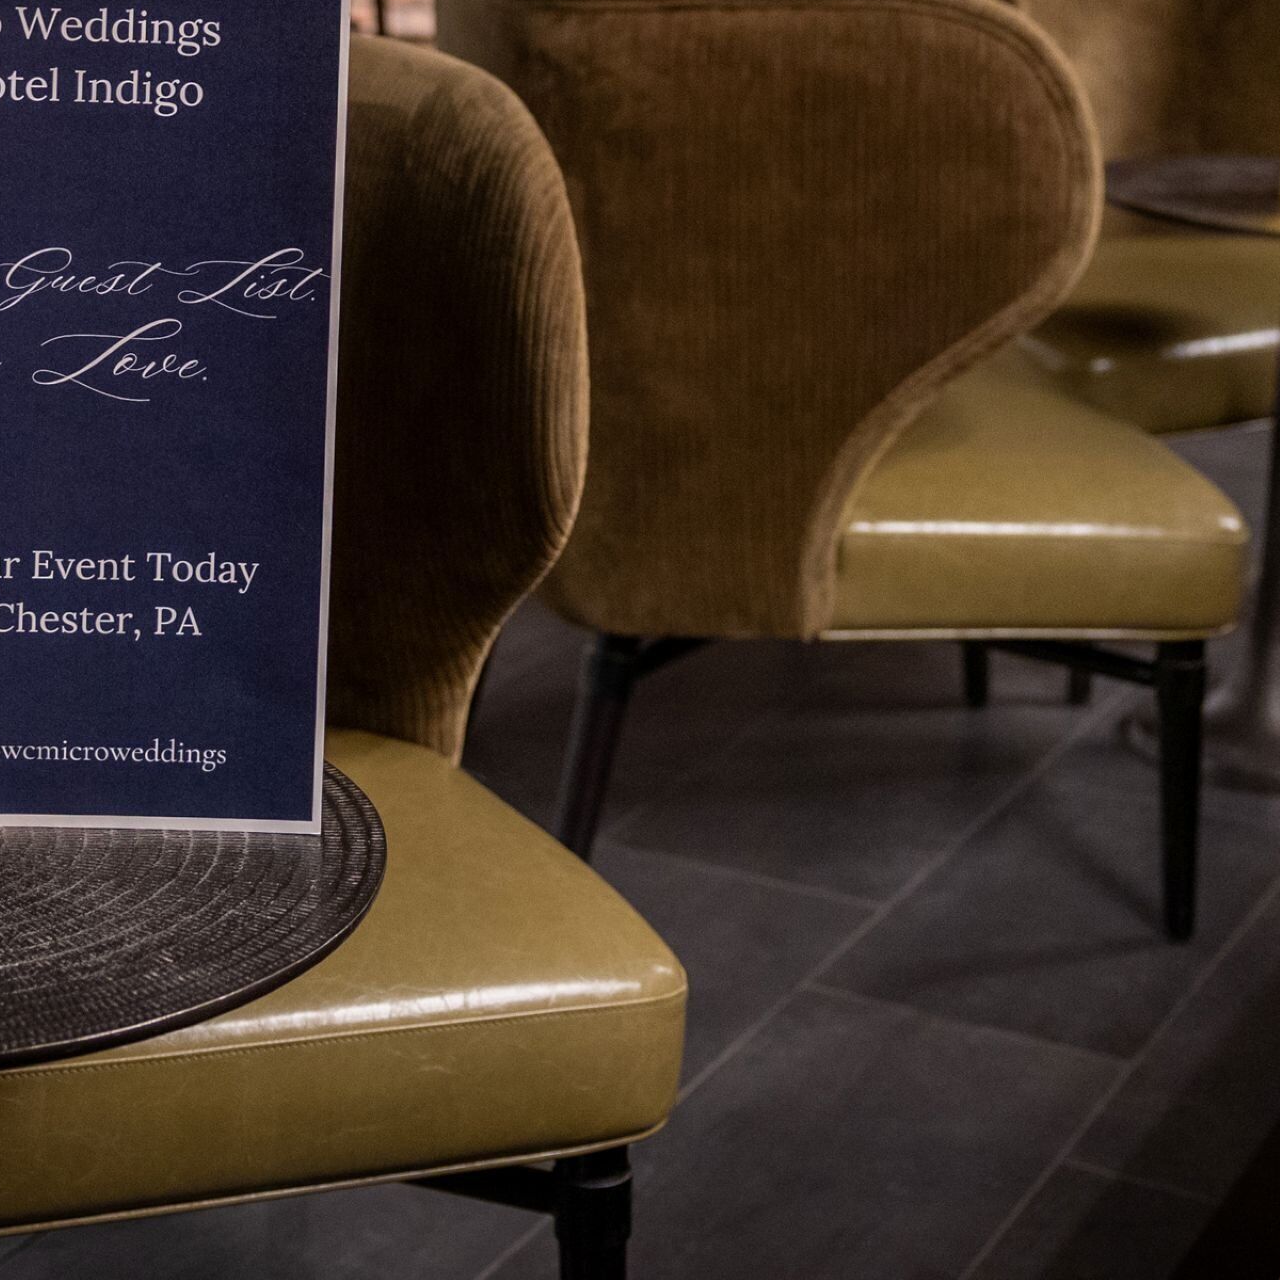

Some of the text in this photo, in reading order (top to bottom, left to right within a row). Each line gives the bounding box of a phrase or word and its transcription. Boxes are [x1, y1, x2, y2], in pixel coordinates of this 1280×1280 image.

[14, 6, 222, 57] Weddings
[73, 69, 204, 118] Indigo
[177, 247, 330, 319] List.
[31, 317, 208, 402] Love.
[31, 549, 136, 582] Event
[146, 551, 260, 595] Today
[153, 605, 203, 637] PA
